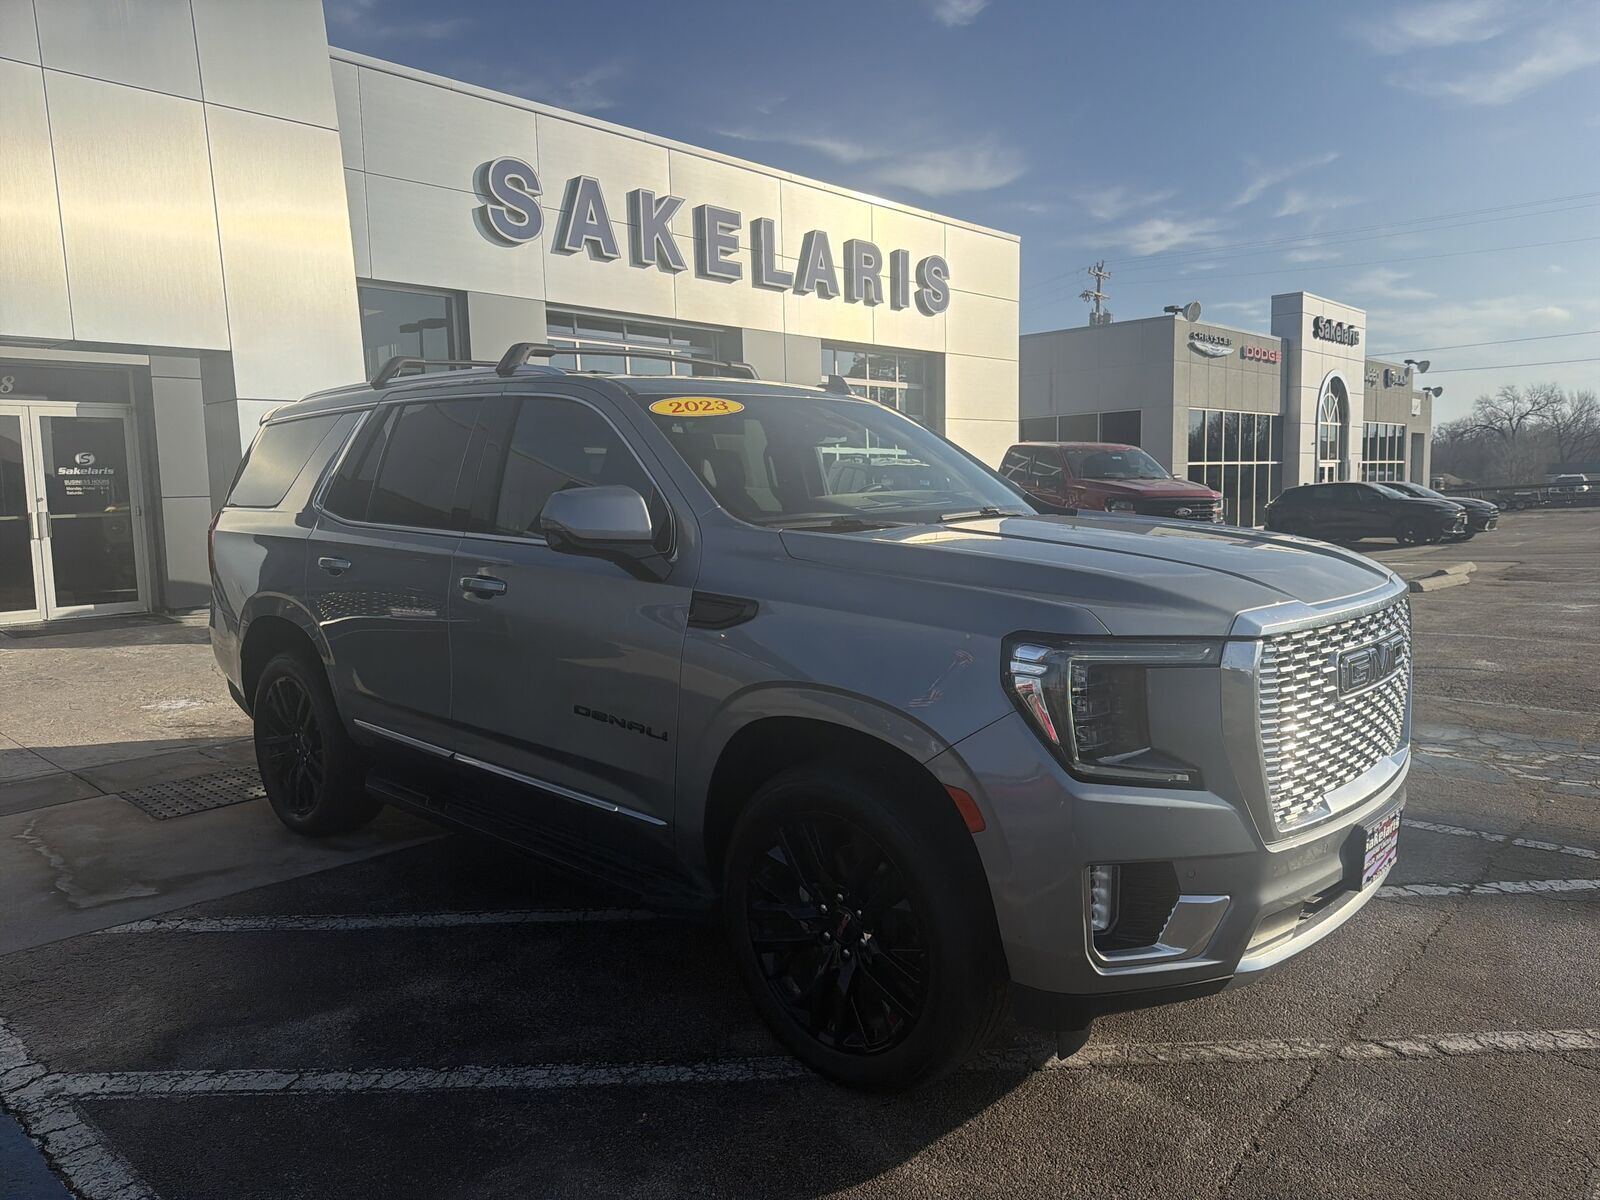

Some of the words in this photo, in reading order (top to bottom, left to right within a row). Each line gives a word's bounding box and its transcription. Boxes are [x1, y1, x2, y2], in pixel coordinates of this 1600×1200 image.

[472, 156, 950, 317] SAKELARIS
[1313, 316, 1360, 346] Sakelaris
[1245, 346, 1282, 362] DODGE
[668, 400, 729, 413] 2023
[58, 467, 114, 475] Sakelaris
[1341, 635, 1404, 694] GMC
[573, 704, 668, 741] DENALI
